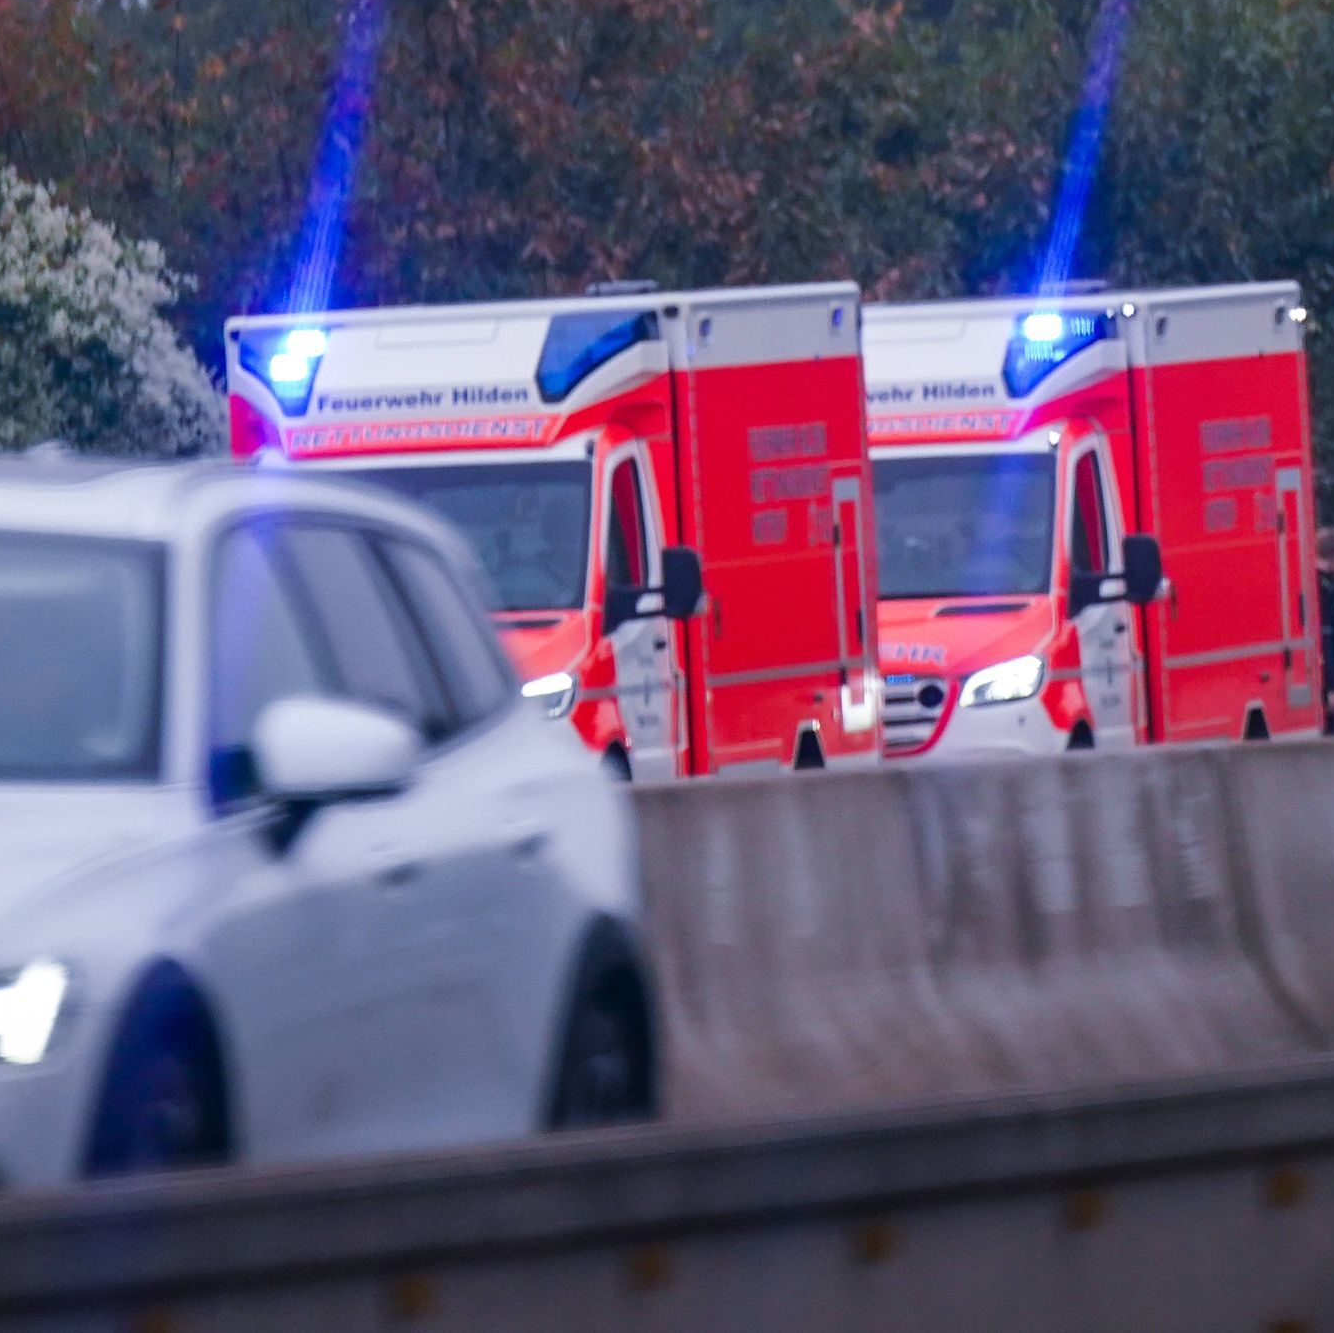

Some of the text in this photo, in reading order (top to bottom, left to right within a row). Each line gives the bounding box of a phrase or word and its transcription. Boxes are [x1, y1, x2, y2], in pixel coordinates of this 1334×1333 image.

[317, 385, 528, 414] Feuerwehr Hilden
[922, 383, 994, 401] Hilden
